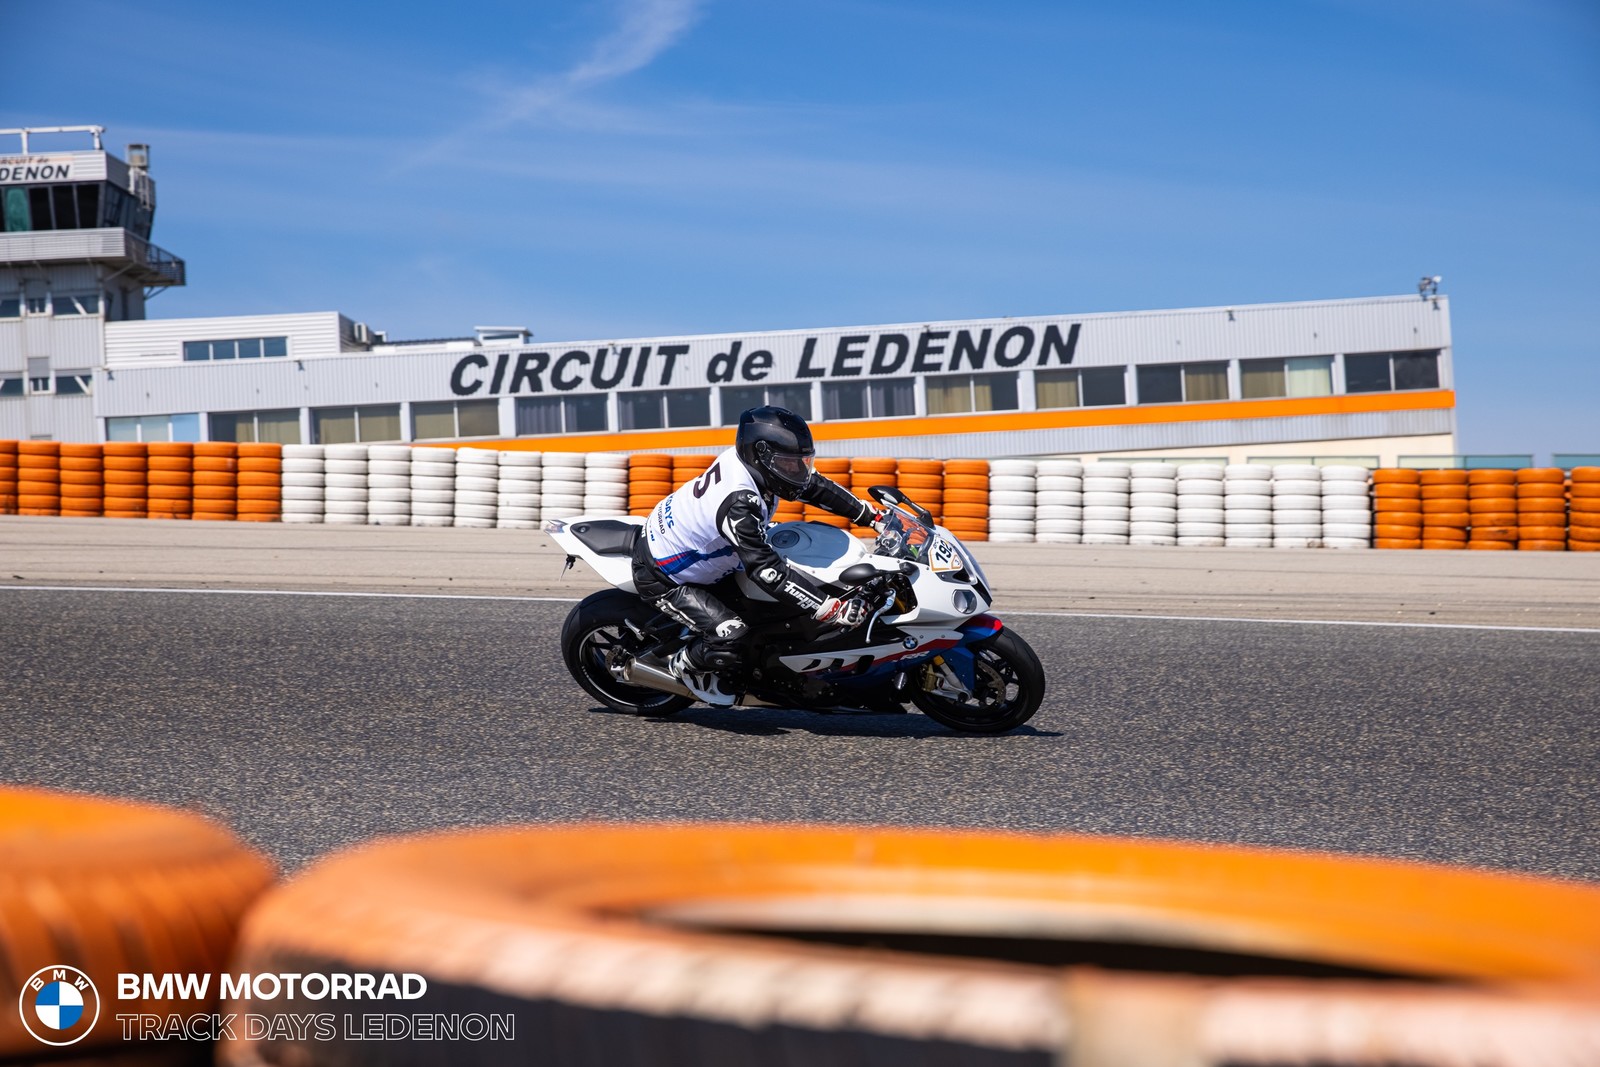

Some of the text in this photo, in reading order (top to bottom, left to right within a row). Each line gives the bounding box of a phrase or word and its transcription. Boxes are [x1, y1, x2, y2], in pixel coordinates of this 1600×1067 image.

[0, 164, 70, 181] DENON
[450, 323, 1081, 396] CIRCUIT de LEDENON
[693, 462, 722, 499] 5
